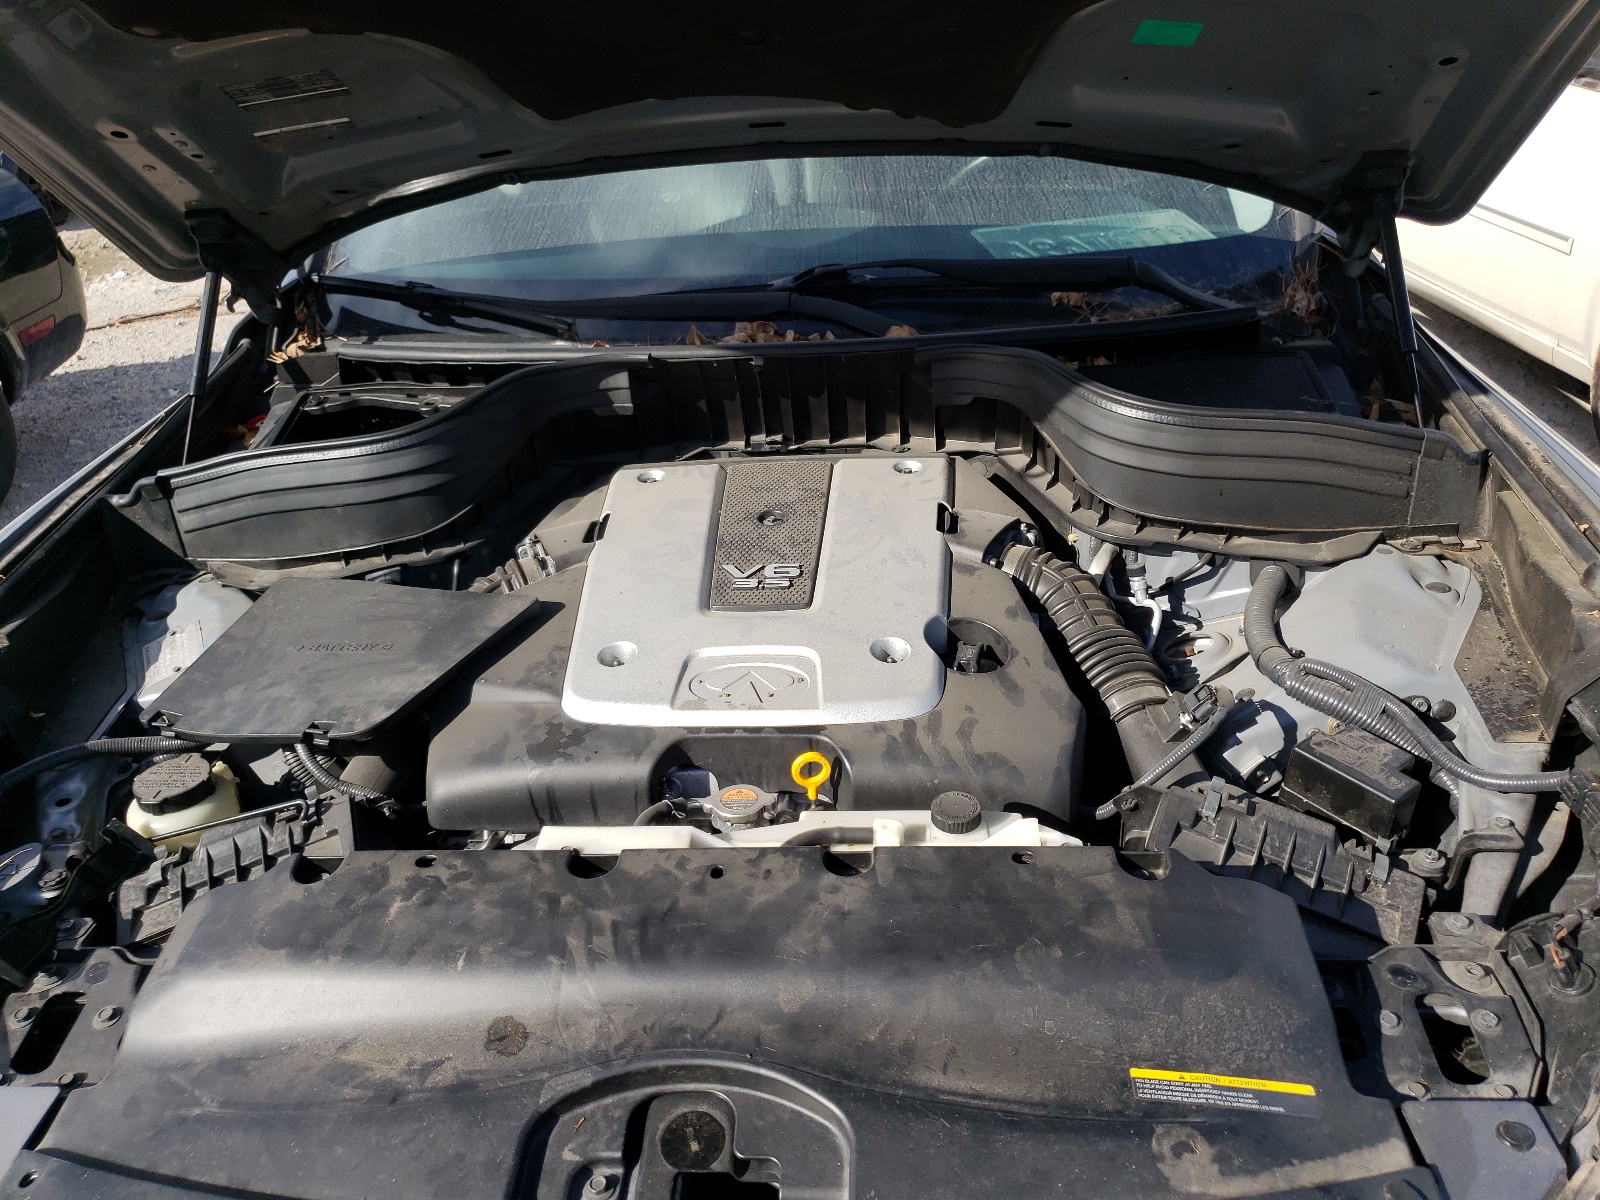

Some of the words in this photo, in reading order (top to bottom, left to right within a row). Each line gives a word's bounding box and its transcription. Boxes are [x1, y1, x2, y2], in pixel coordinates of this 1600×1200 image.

[721, 563, 803, 579] V6
[732, 578, 793, 589] 3.5
[1189, 1075, 1221, 1083] CAUTION
[1228, 1079, 1267, 1088] ATTENTION
